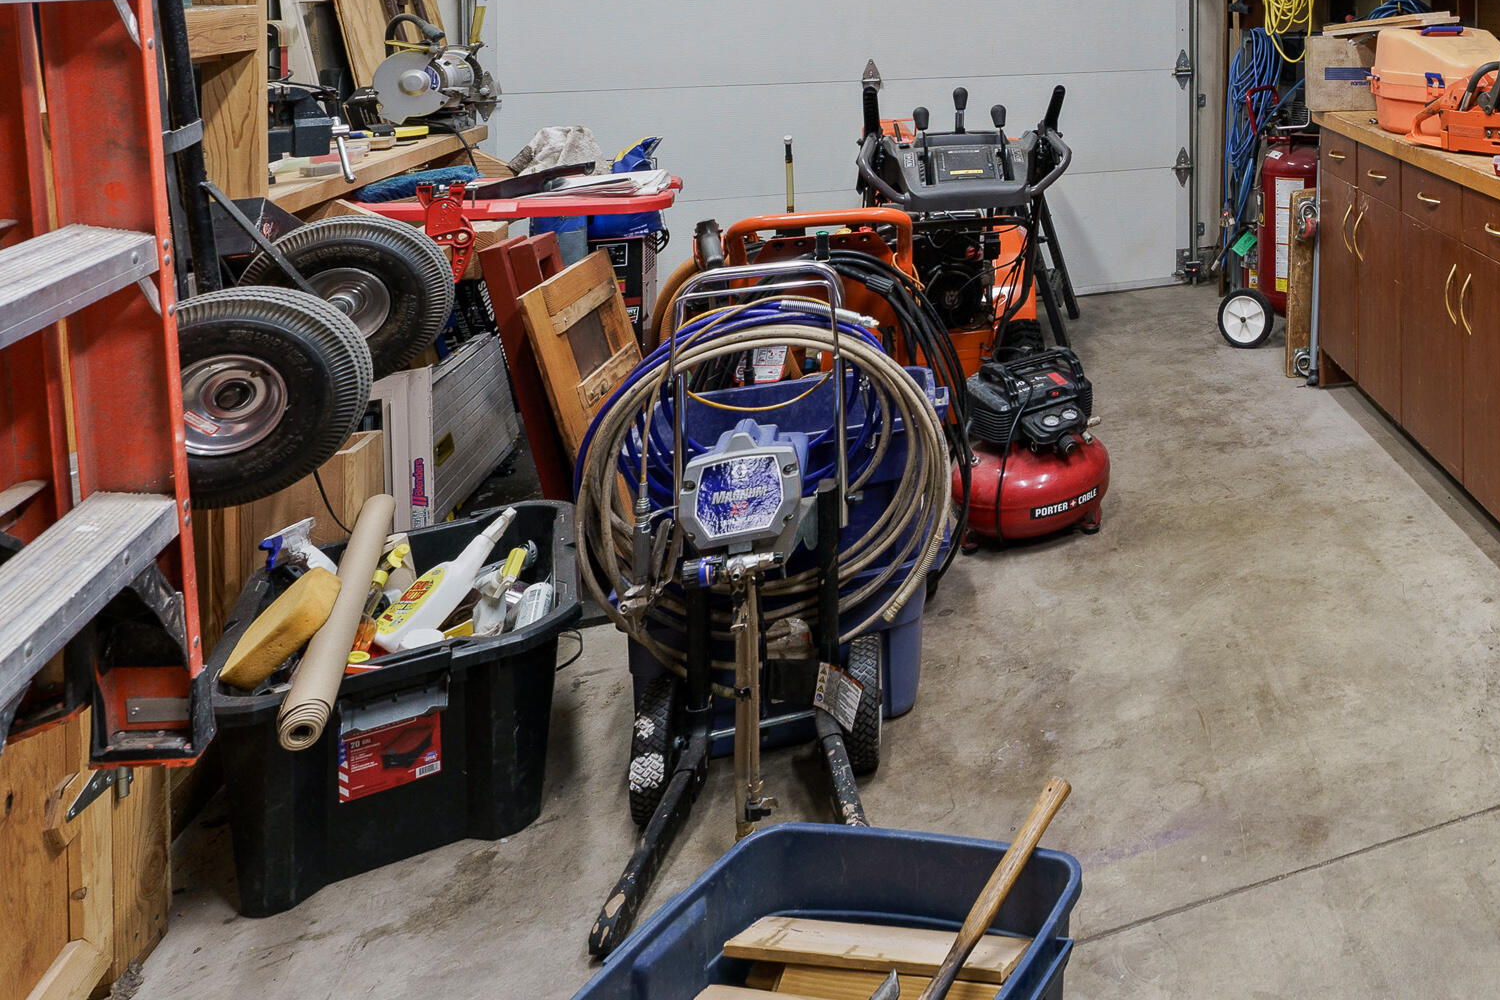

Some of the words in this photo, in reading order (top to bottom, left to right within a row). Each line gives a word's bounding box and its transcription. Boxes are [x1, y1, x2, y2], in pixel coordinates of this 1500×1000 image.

[711, 485, 768, 505] MAGNUM
[1035, 501, 1069, 518] PORTER
[1078, 488, 1097, 505] CABLE
